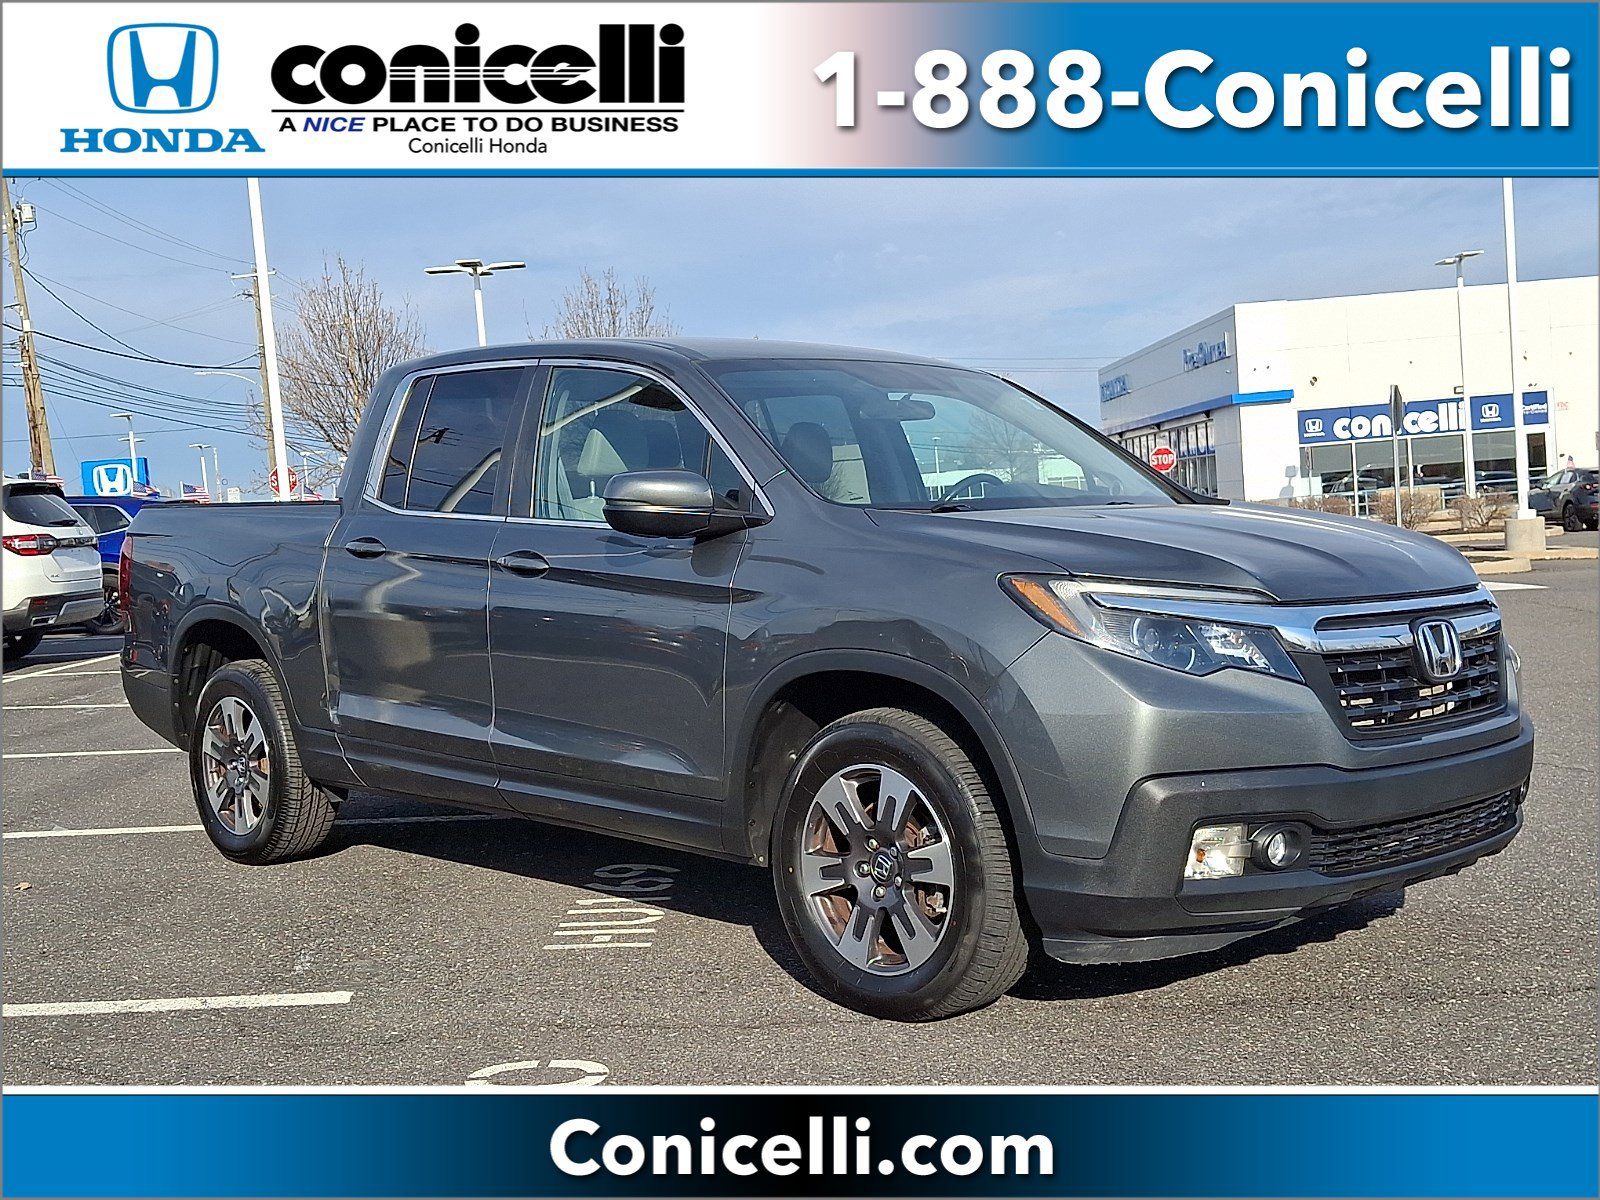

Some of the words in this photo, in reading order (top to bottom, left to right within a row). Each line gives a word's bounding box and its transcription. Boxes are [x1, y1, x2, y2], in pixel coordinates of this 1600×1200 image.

[1332, 401, 1465, 440] concelli
[1151, 453, 1174, 466] STOP
[271, 474, 296, 487] SP
